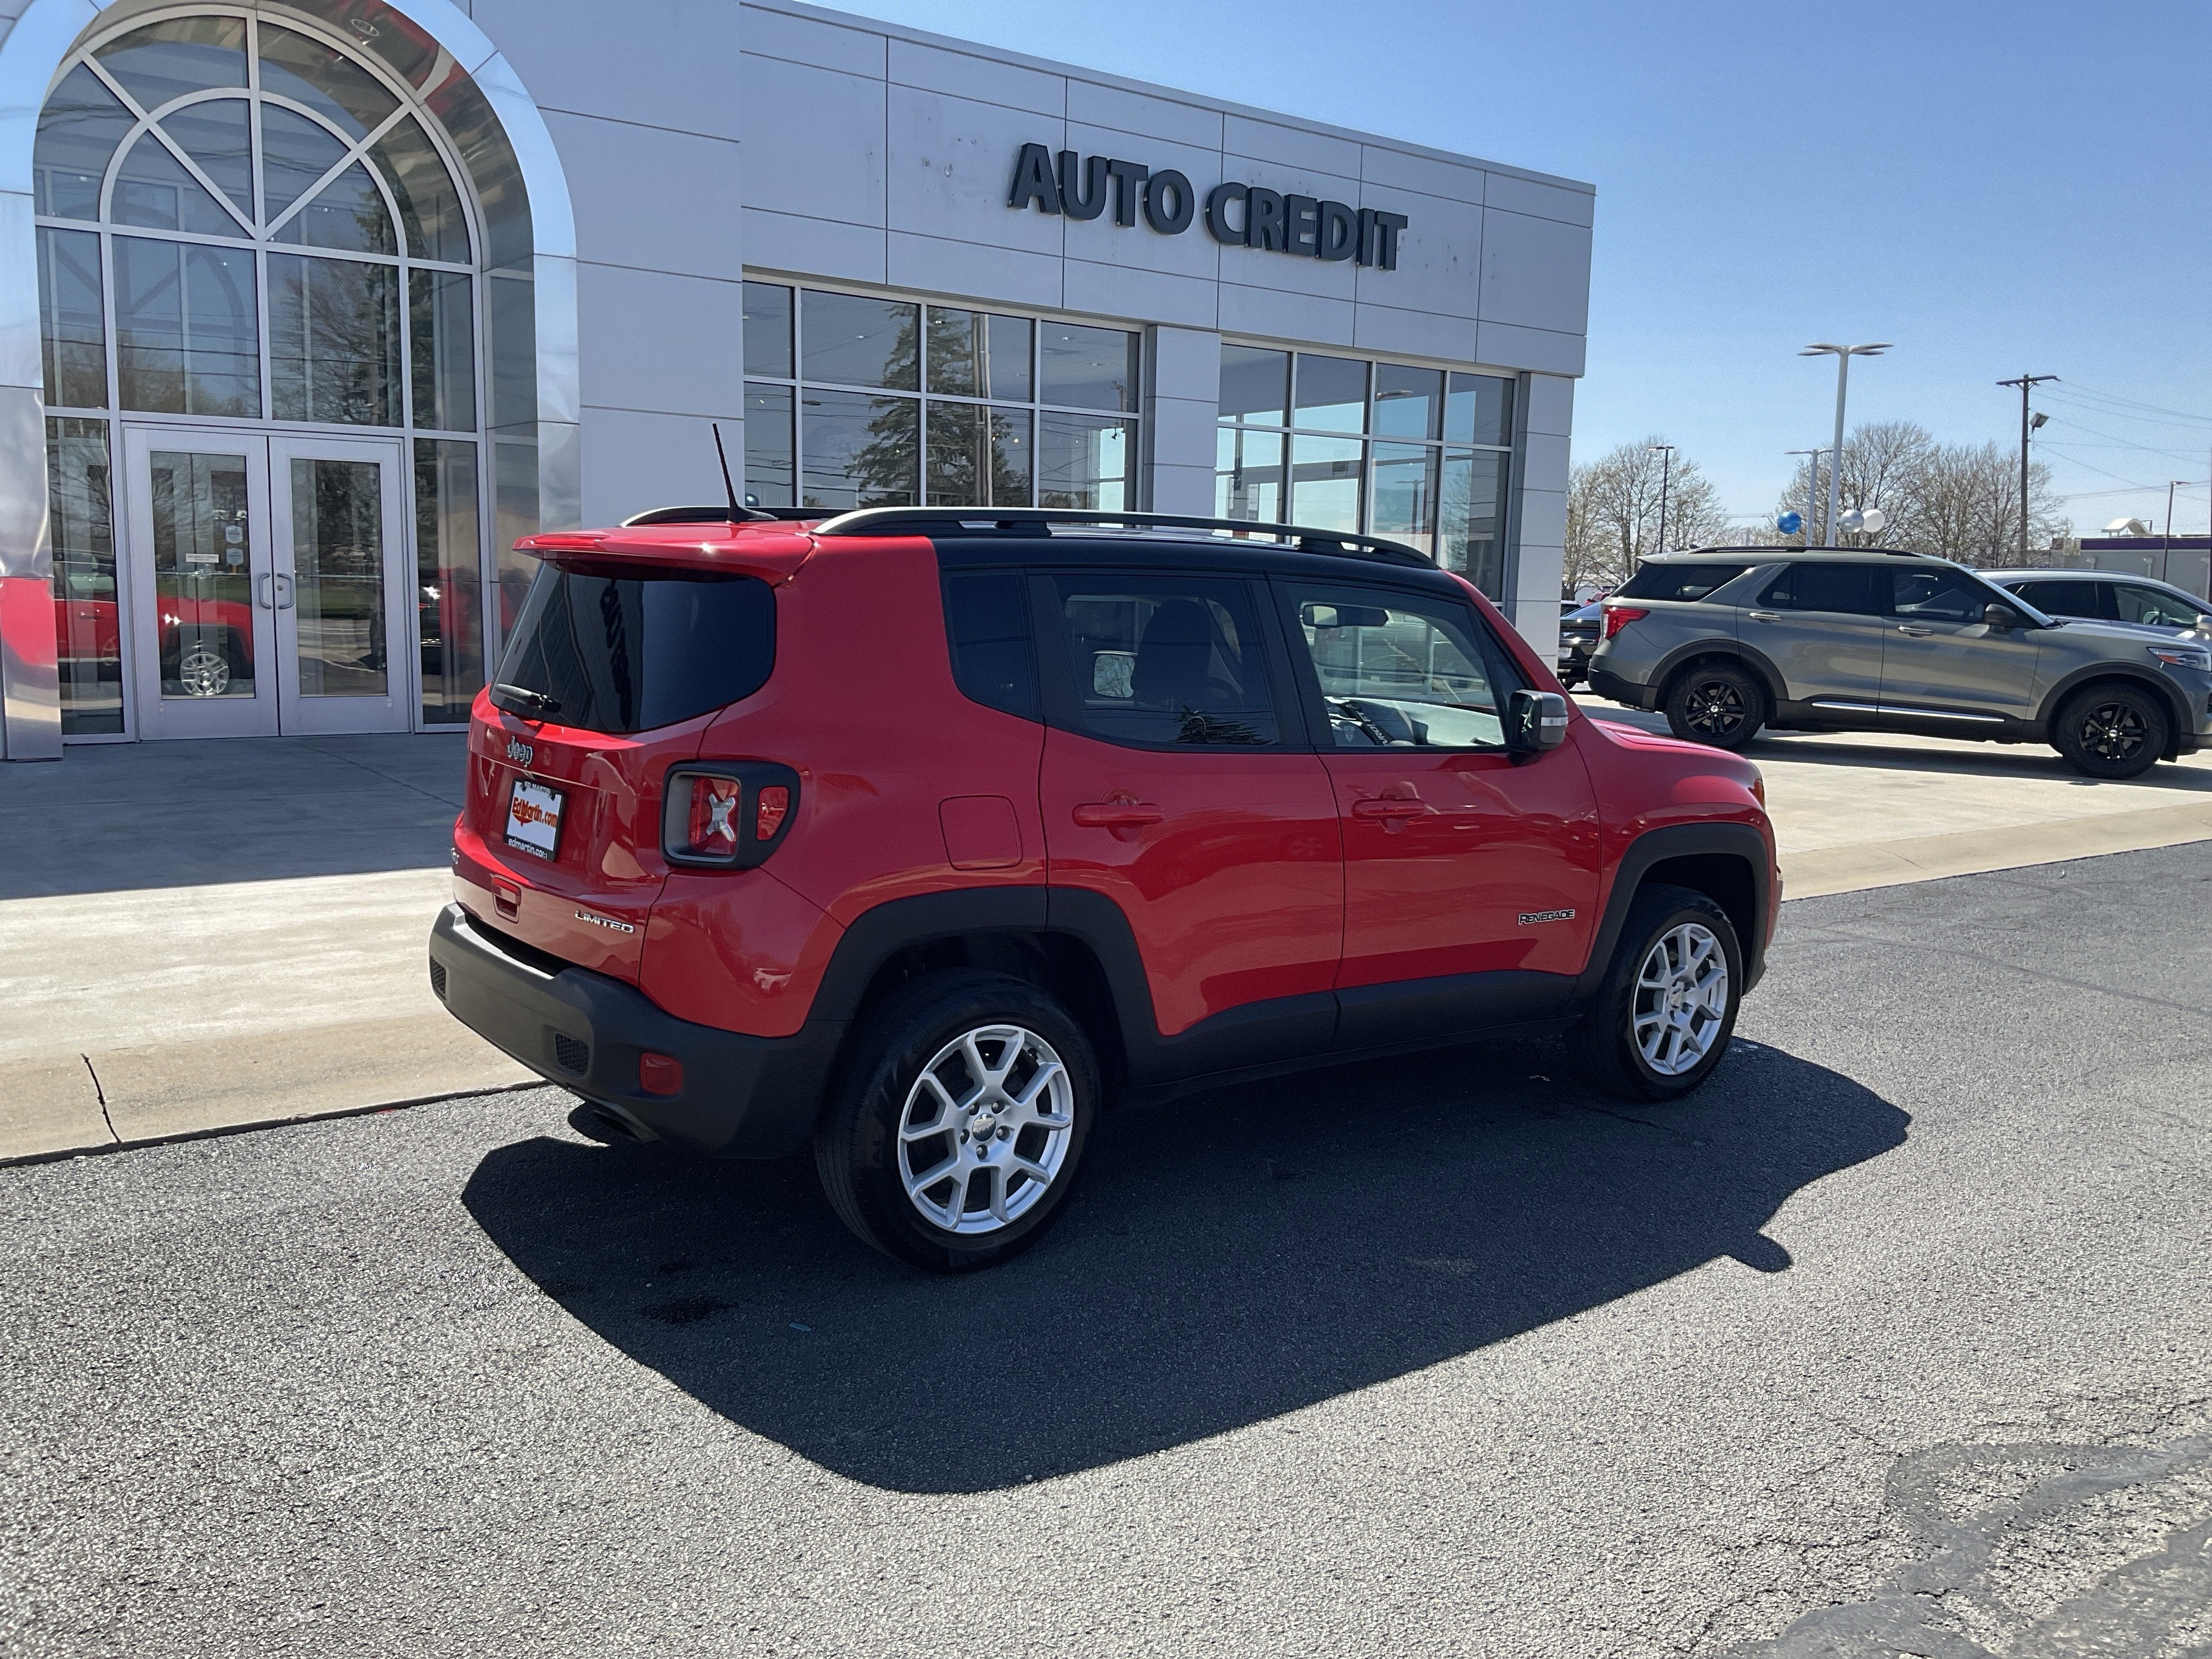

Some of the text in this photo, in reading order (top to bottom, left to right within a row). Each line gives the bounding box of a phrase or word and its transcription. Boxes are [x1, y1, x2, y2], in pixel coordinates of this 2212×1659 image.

[1007, 142, 1408, 271] AUTO CREDIT
[507, 736, 533, 768] Jeep
[532, 783, 551, 794] MARTIN
[512, 797, 558, 828] EdMartin.com
[508, 838, 548, 859] edmartin.com
[575, 910, 634, 933] LIMITED
[1518, 909, 1575, 925] RENEGADE
